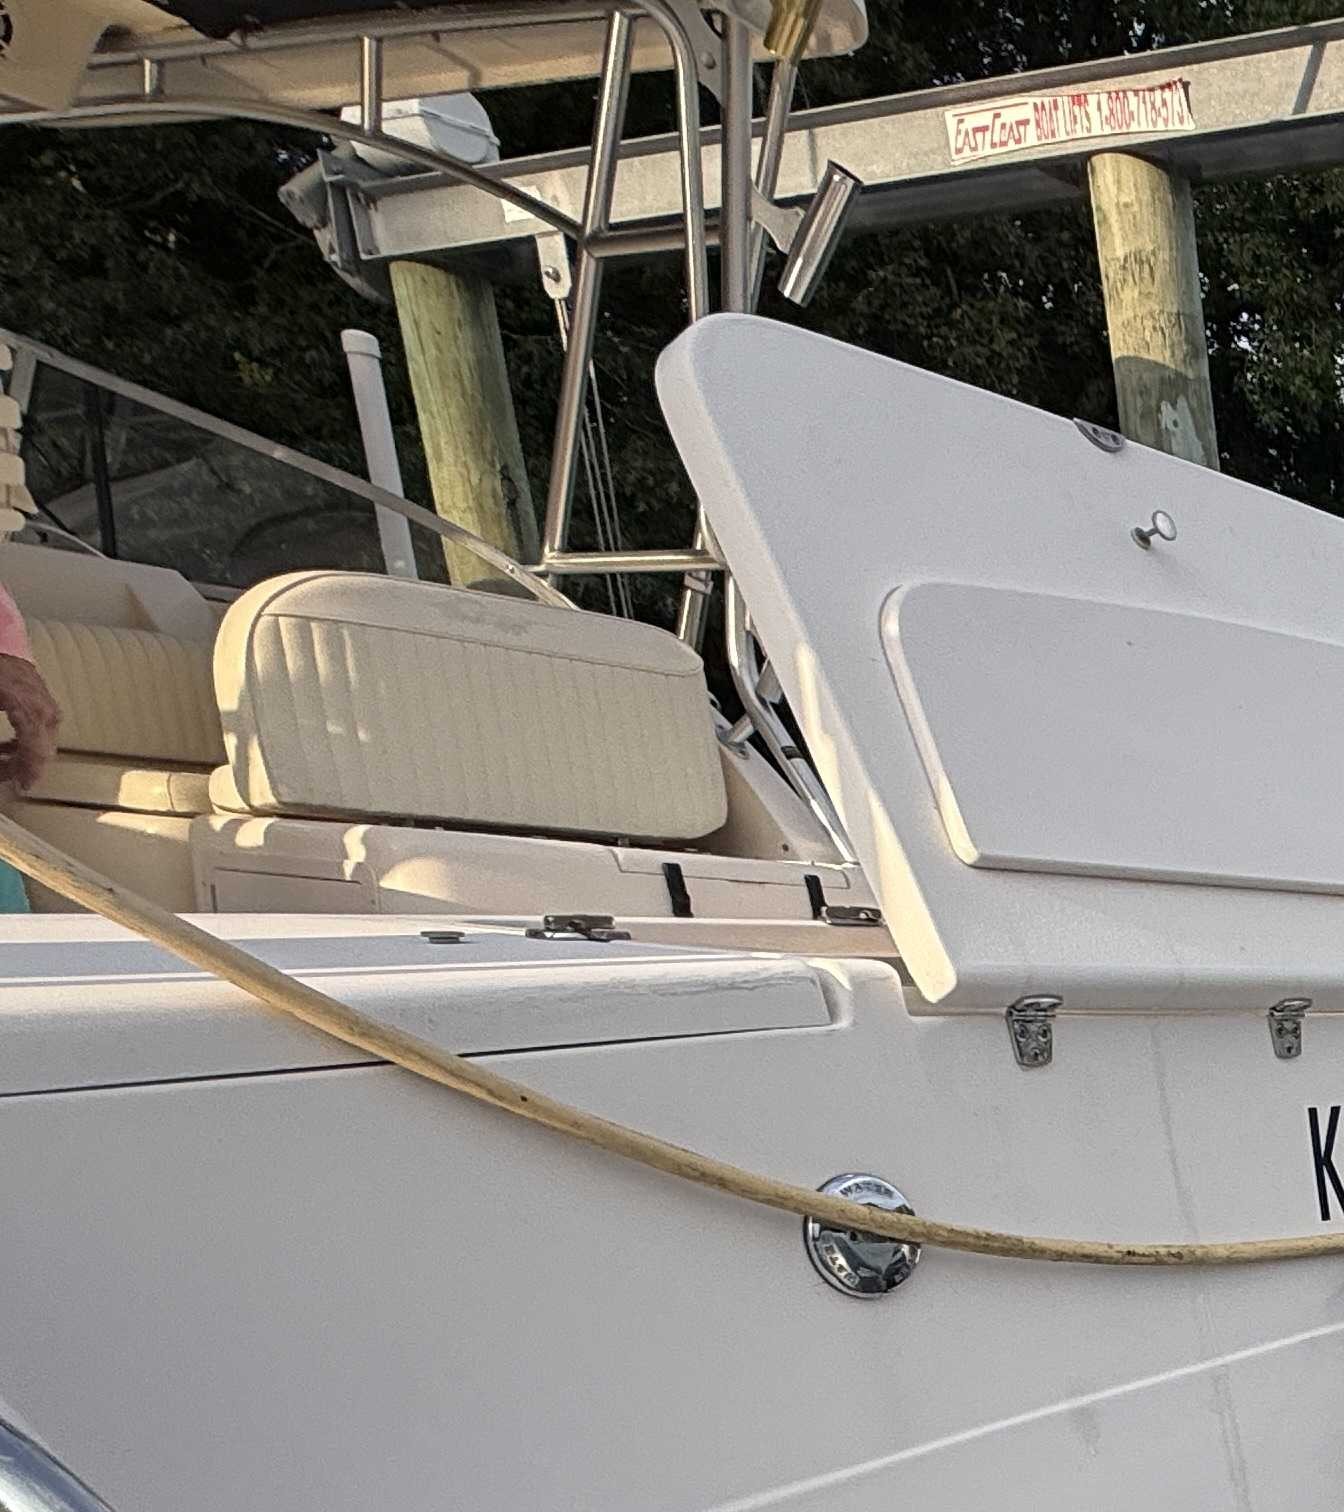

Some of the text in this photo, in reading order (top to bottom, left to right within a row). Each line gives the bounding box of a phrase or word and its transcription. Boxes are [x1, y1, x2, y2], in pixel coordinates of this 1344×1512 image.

[954, 118, 990, 155] EAST
[990, 112, 1030, 149] COAST
[1033, 97, 1061, 141] BOAT
[1061, 93, 1092, 137] LIFTS
